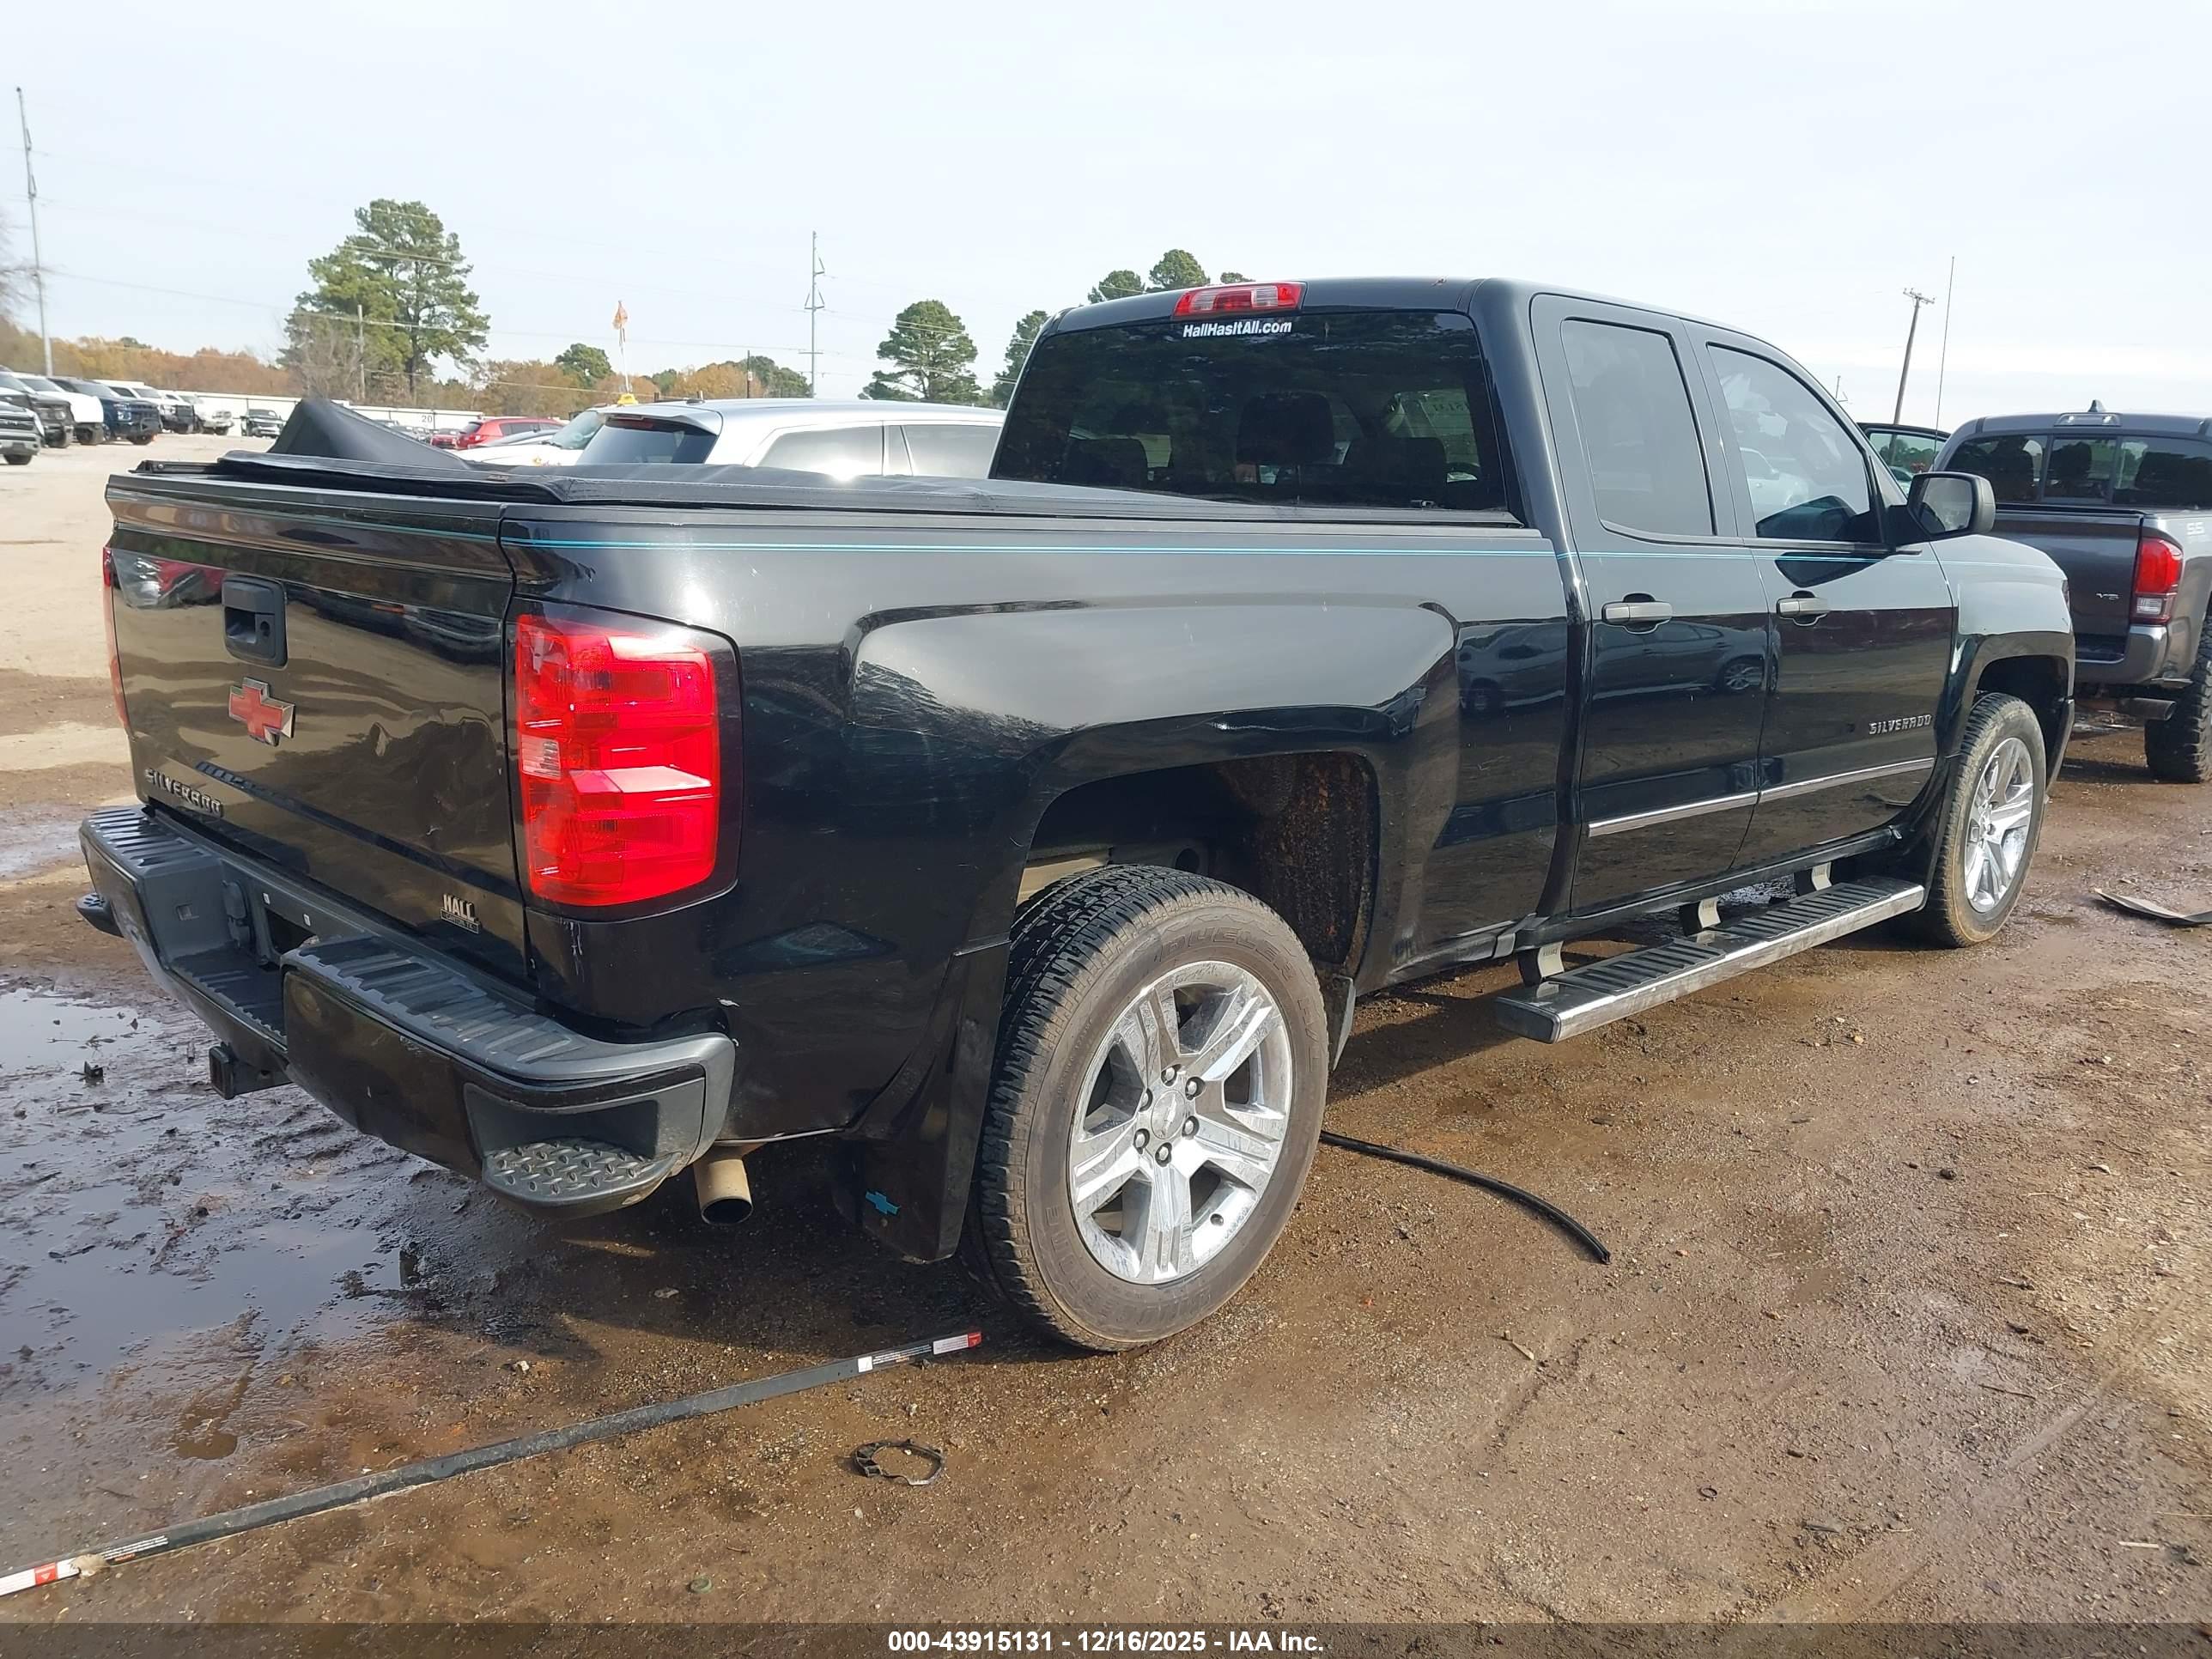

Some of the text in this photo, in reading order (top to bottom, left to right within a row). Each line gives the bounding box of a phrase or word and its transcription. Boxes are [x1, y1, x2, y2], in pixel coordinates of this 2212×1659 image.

[1182, 320, 1292, 337] HallHasItAll.com
[421, 415, 433, 423] 20
[1869, 714, 1932, 735] SILVERADO
[144, 768, 223, 815] SILVERADO
[443, 893, 477, 923] HALL
[1154, 926, 1297, 981] DUELER
